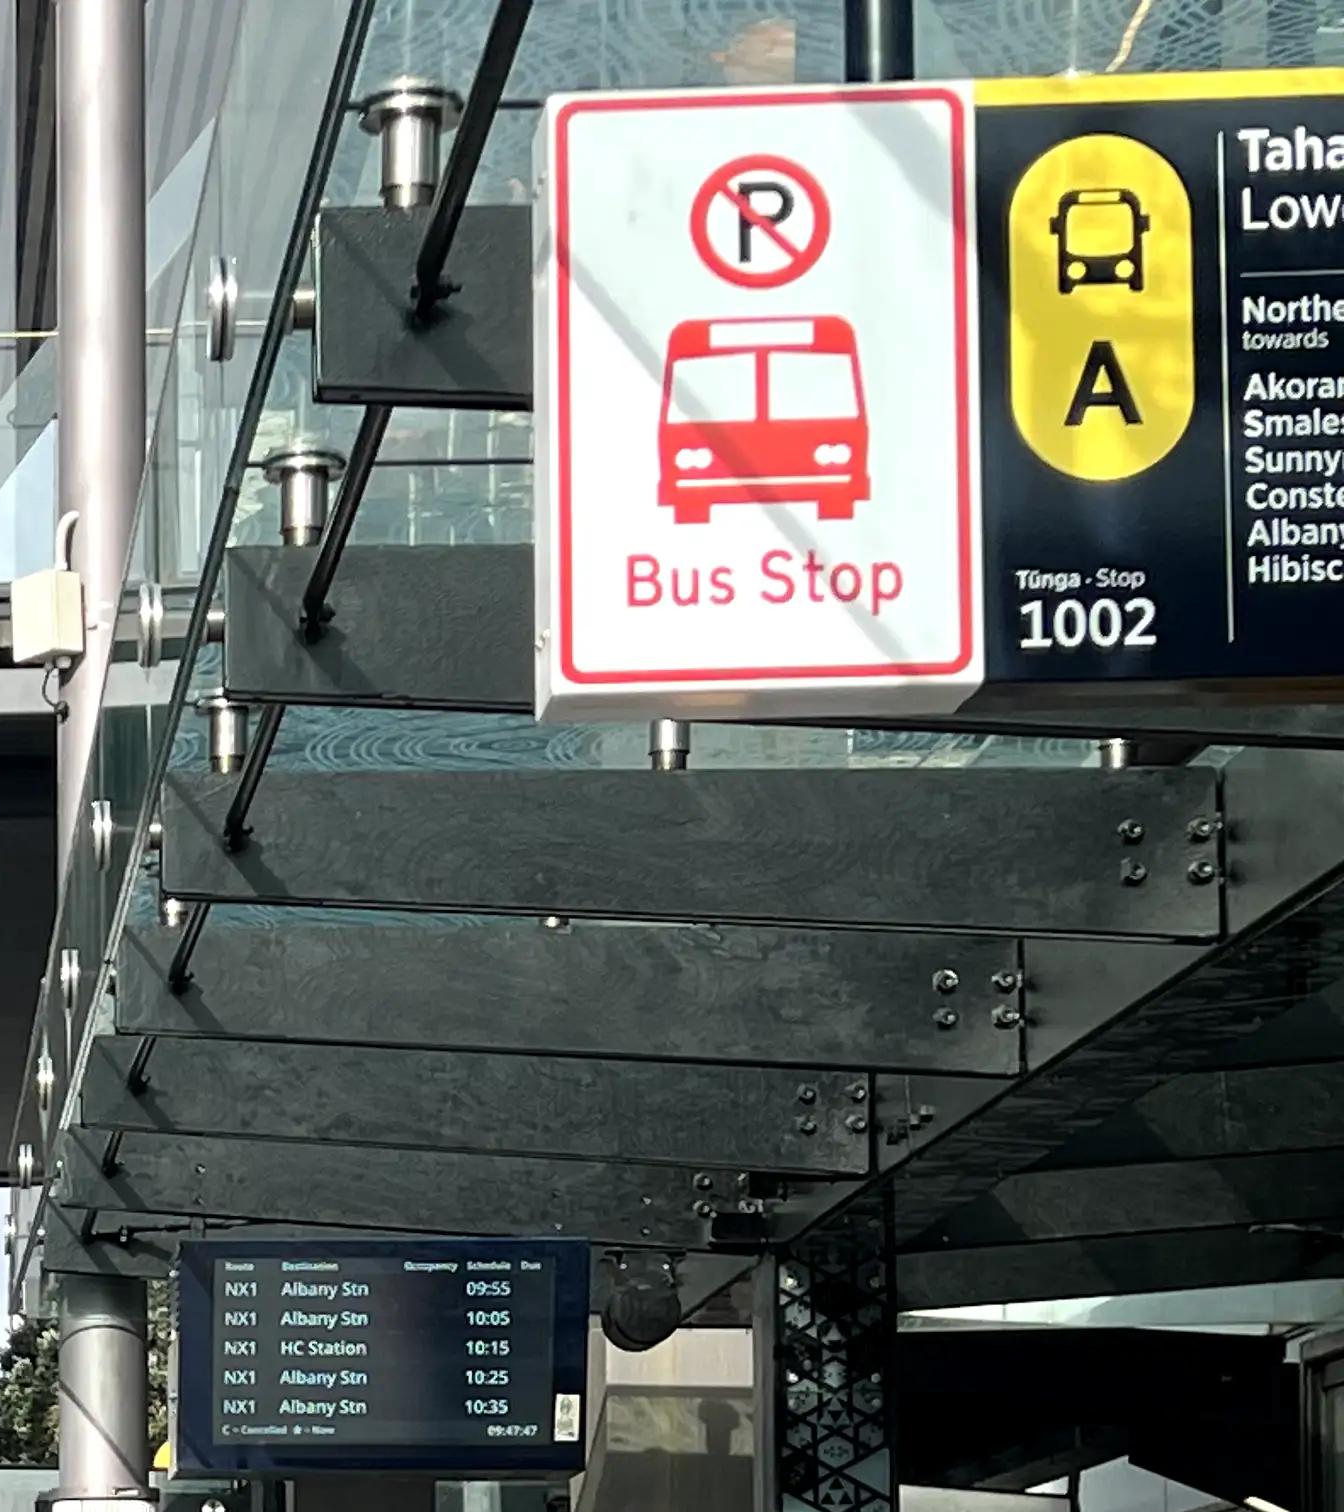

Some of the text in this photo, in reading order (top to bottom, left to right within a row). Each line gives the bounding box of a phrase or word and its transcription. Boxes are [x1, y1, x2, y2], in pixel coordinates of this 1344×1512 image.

[1237, 125, 1344, 173] Taha
[1241, 186, 1344, 231] Low
[1241, 327, 1329, 350] towards
[1062, 340, 1144, 427] A
[1243, 406, 1344, 438] Smale
[1244, 445, 1344, 477] Sunny
[1246, 517, 1344, 549] Alban
[626, 549, 904, 616] Bus Stop
[1095, 567, 1147, 590] Stop
[1247, 553, 1344, 584] Hibisc
[1019, 597, 1158, 649] 1002
[224, 1281, 511, 1300] NX1 Albany Stn 09:55
[224, 1311, 511, 1330] NX1 Albany Stn 10:05
[224, 1340, 510, 1356] NX1 HC Station 10:15
[223, 1370, 509, 1388] NX1 Albany Stn 10:25
[223, 1399, 509, 1418] NX1 Albany Stn 10:35
